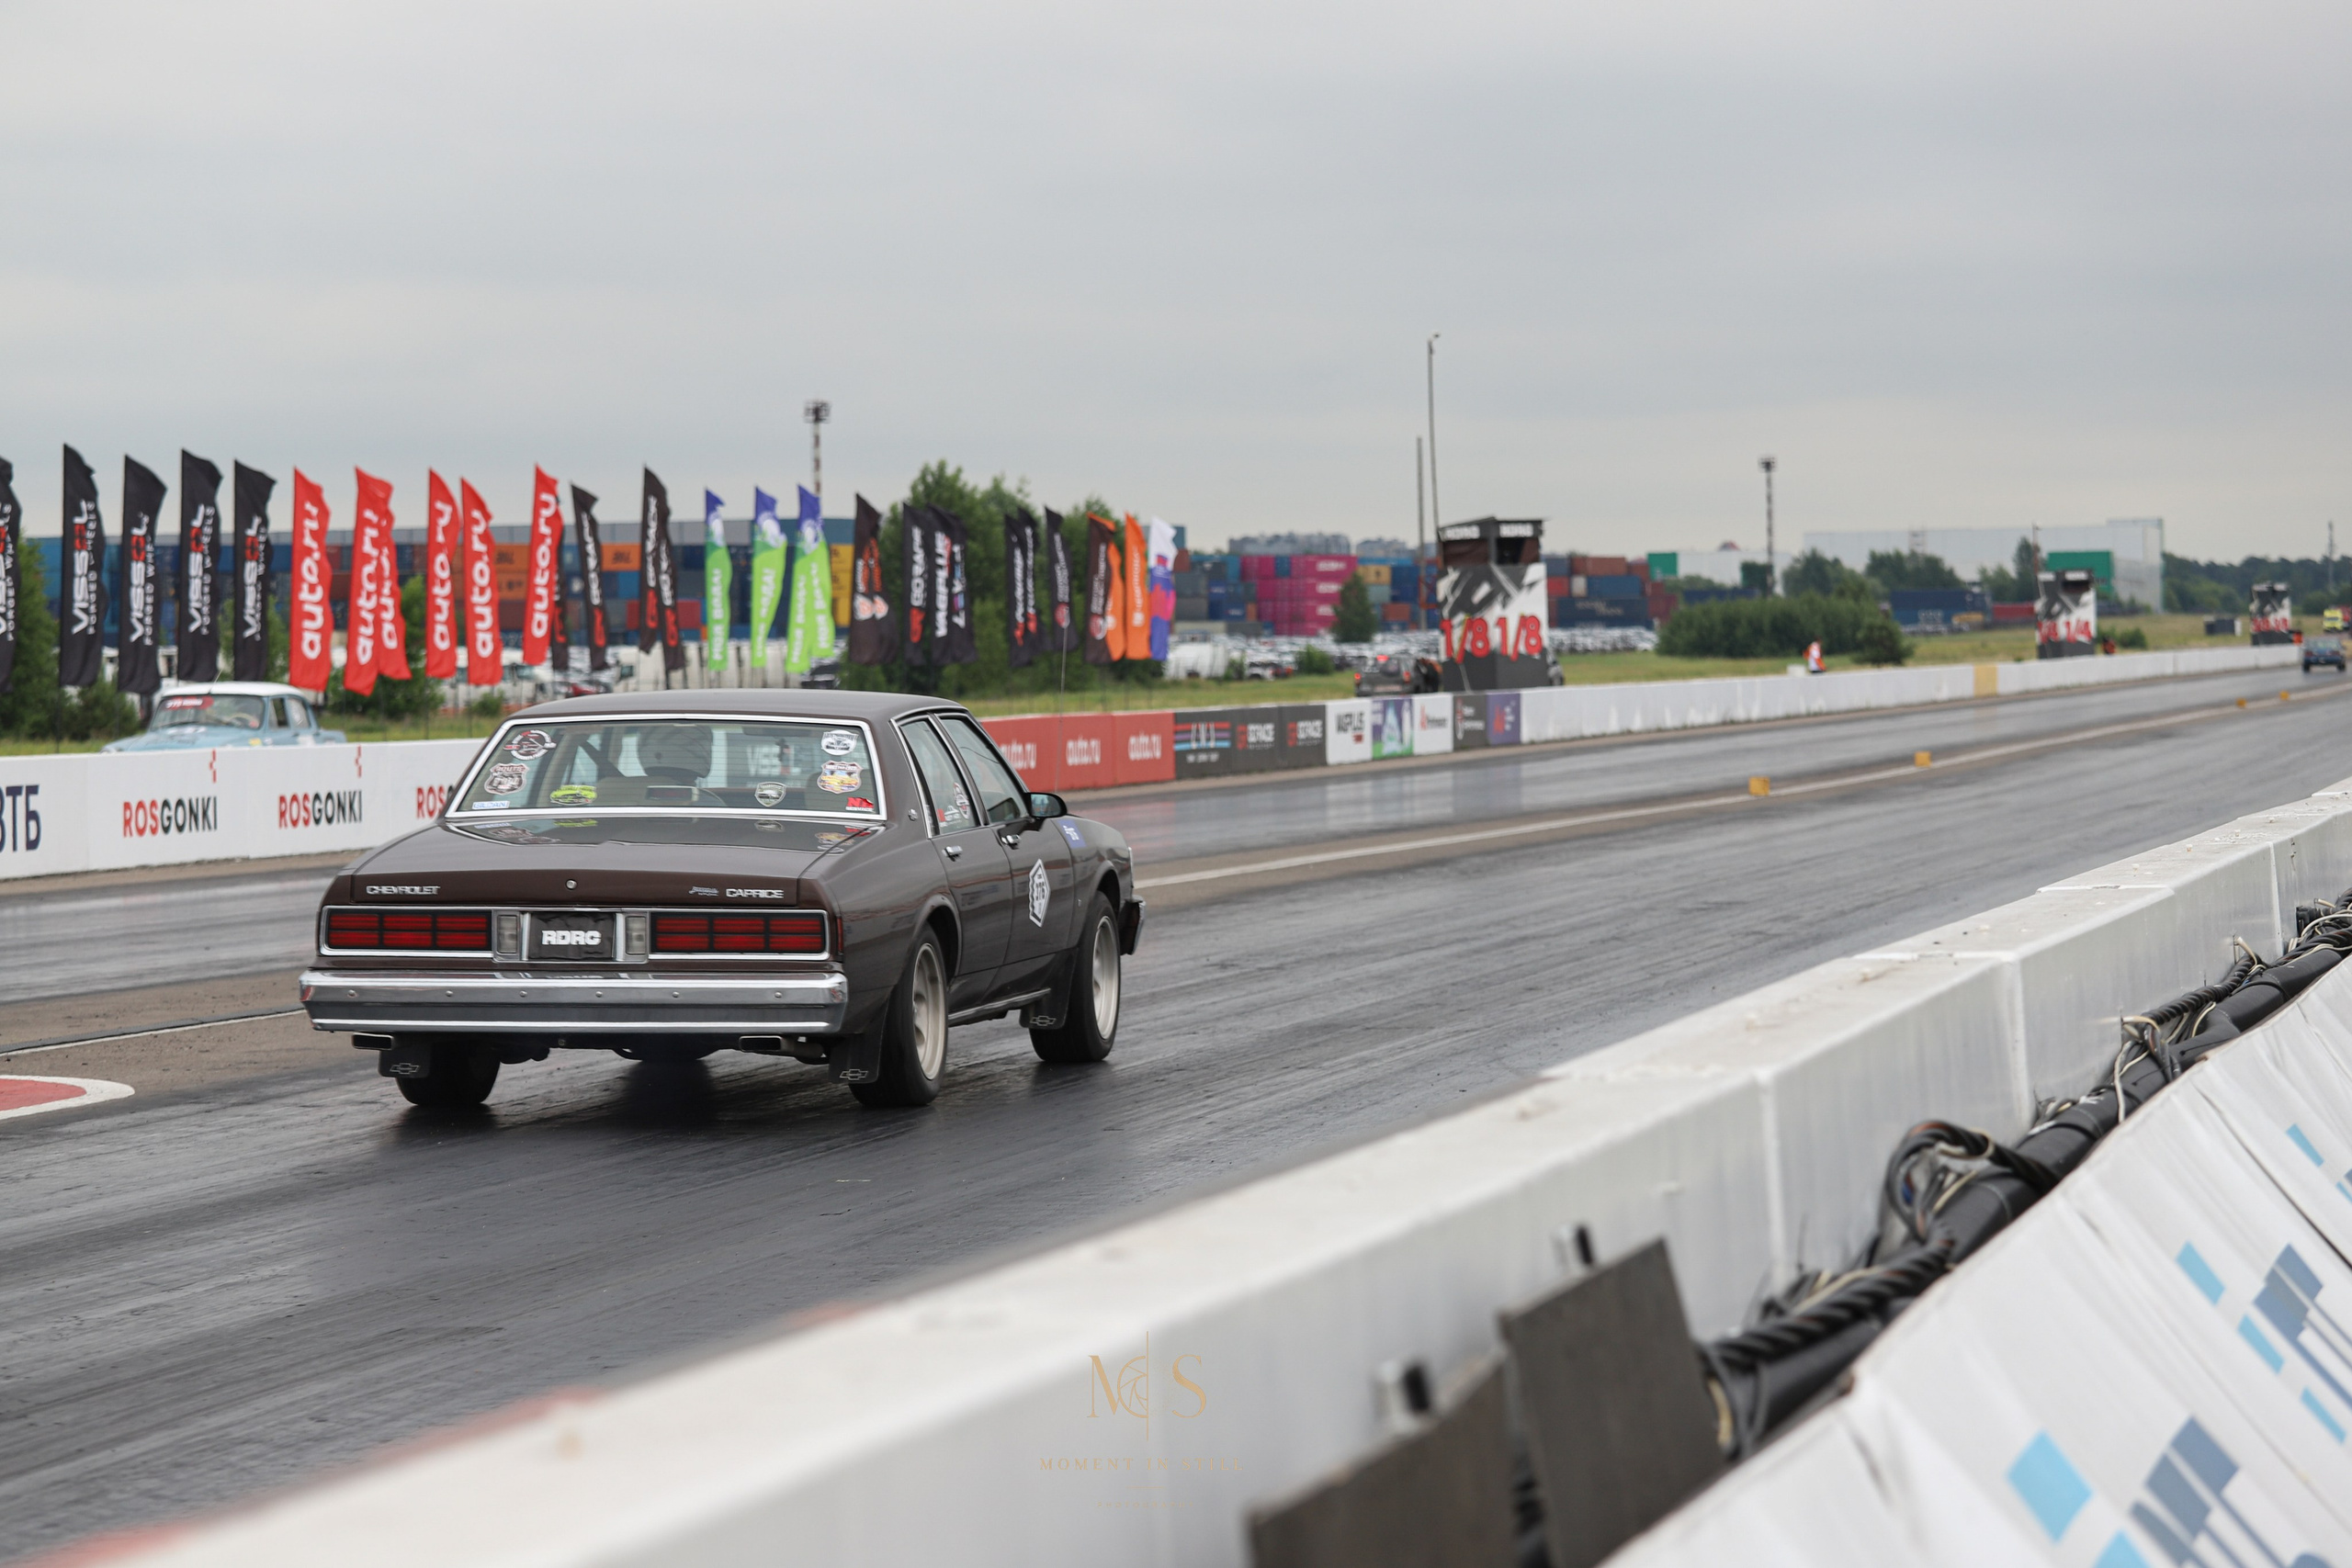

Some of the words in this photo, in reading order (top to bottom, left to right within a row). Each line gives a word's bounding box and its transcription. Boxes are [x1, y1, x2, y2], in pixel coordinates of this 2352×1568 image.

[470, 509, 493, 658] auto.ru
[531, 492, 557, 638] auto.ru
[1440, 617, 1490, 664] 1/8
[1496, 614, 1543, 661] 1/8
[123, 795, 218, 838] ROSGONKI
[278, 790, 362, 829] ROSGONKI
[367, 886, 441, 895] CHEVROLET
[726, 888, 785, 898] CAPRICE
[541, 930, 602, 945] RDRC
